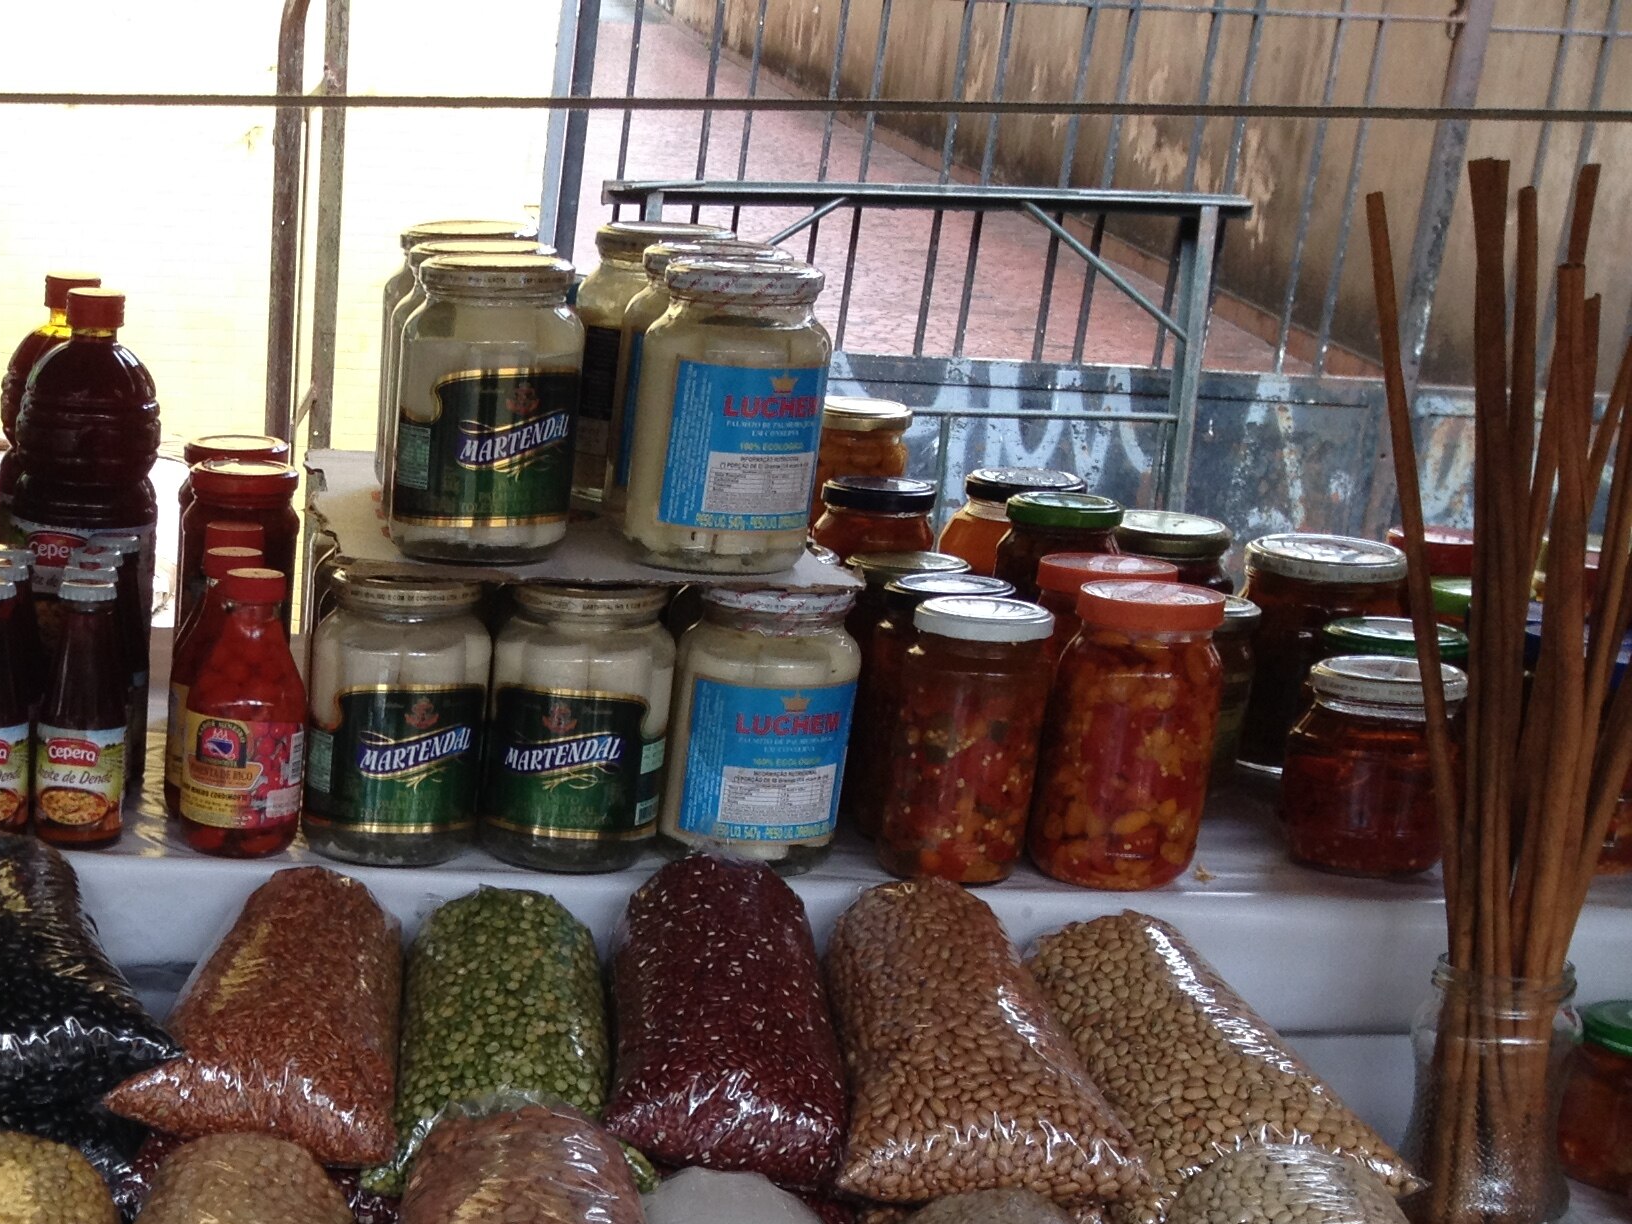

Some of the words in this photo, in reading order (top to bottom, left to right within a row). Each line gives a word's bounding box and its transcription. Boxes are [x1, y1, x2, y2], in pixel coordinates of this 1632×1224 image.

[460, 413, 569, 463] MARTENDAL
[28, 540, 71, 559] Cepe
[48, 745, 96, 762] Cepera
[359, 726, 472, 772] MARTENDAL
[504, 735, 622, 772] MARTENDAL
[61, 769, 76, 783] de
